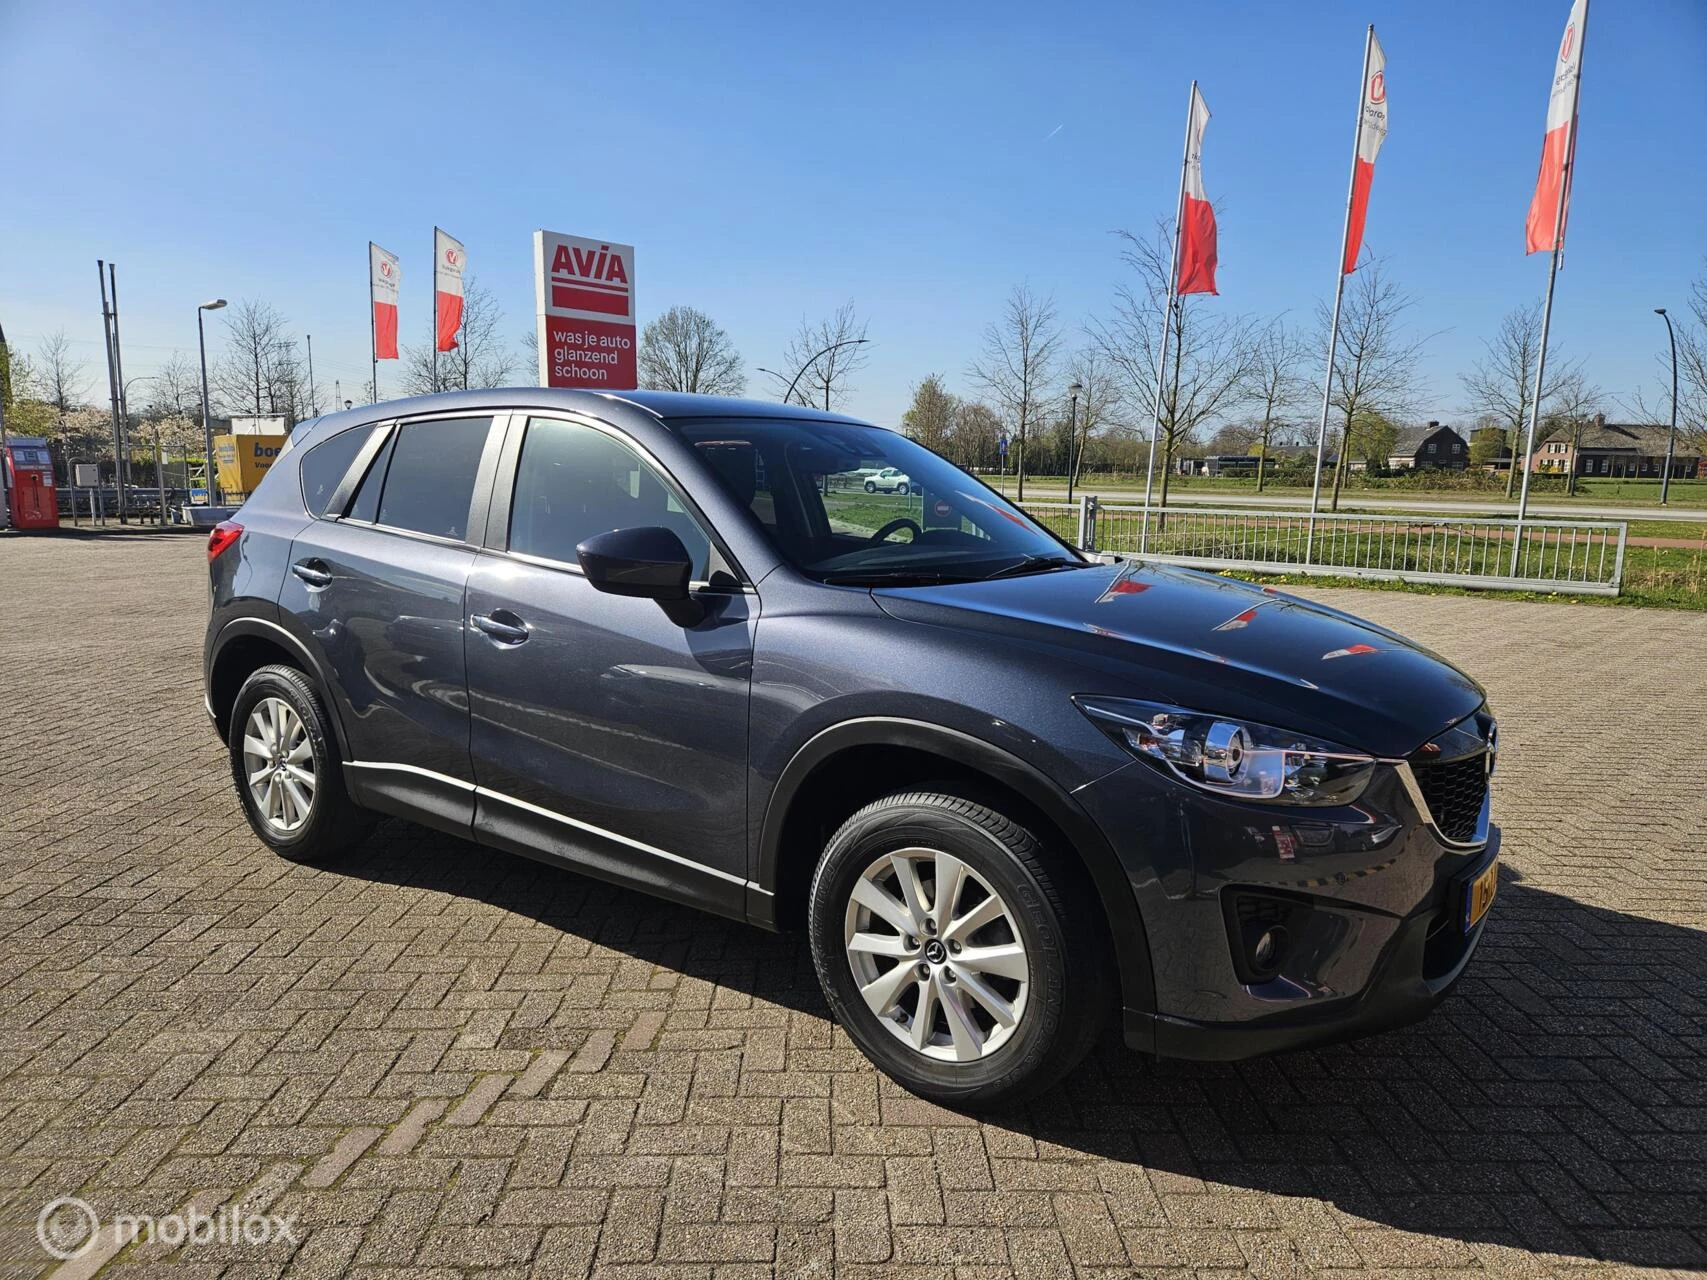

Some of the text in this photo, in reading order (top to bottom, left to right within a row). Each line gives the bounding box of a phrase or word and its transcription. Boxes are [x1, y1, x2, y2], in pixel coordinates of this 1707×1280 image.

[553, 331, 631, 349] was je auto
[554, 348, 618, 364] glanzend
[555, 363, 607, 380] schoon
